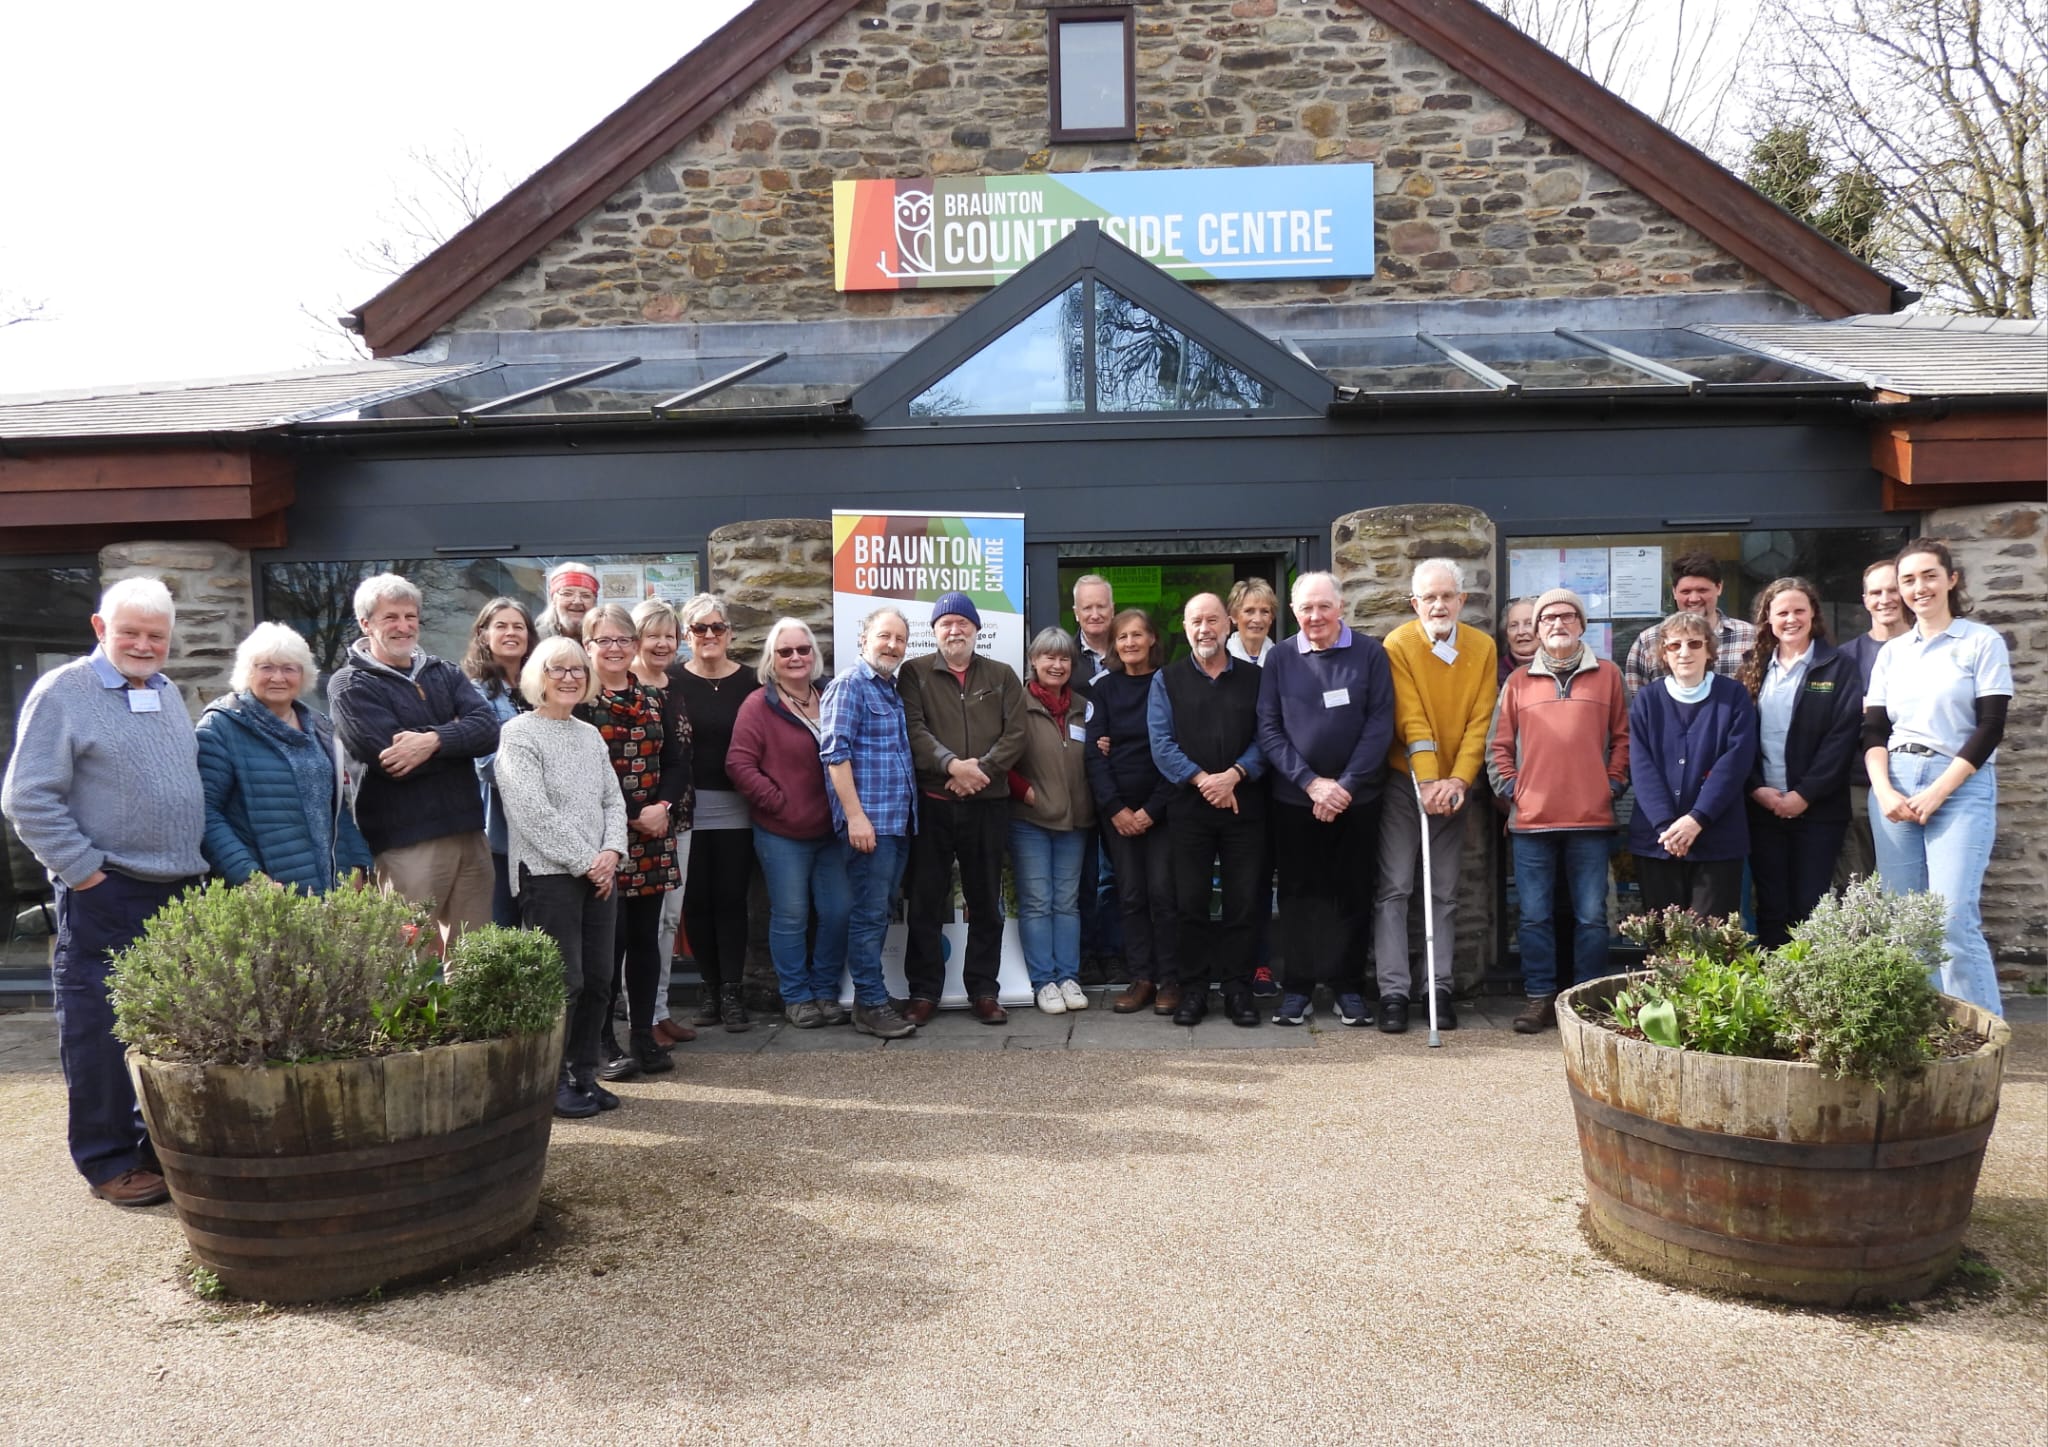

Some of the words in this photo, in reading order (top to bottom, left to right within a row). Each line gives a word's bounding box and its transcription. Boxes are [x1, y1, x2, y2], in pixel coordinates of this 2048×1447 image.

[944, 191, 1043, 217] BRAUNTON
[943, 213, 1183, 264] COUNTSIDE
[1198, 208, 1334, 255] CENTRE
[855, 535, 982, 566] BRAUNTON
[985, 538, 1004, 592] CENTRE
[855, 567, 981, 591] COUNTRYSIDE
